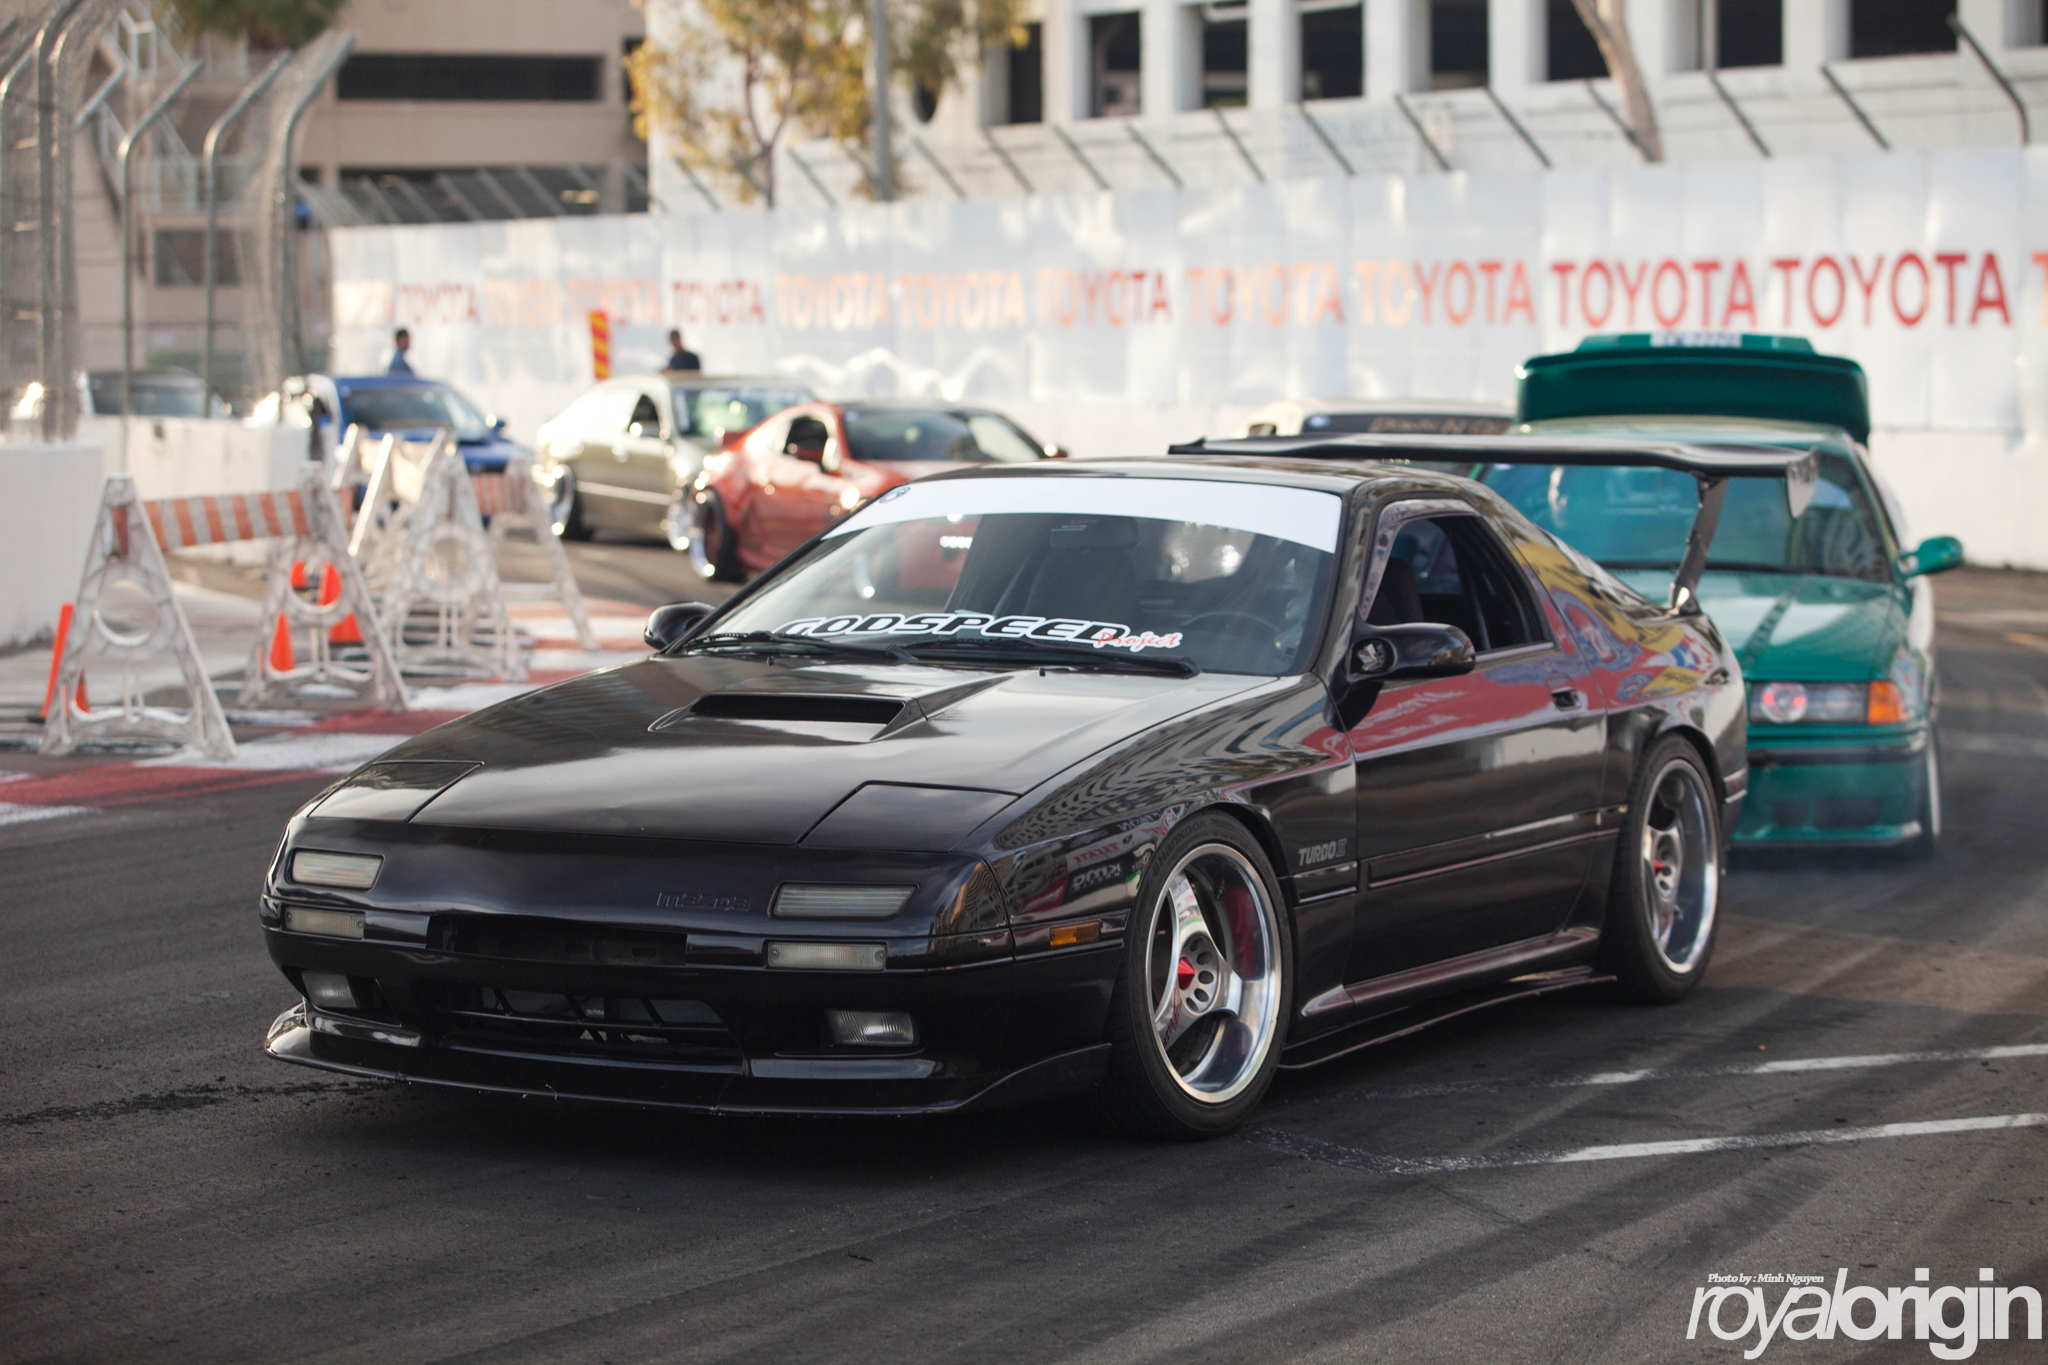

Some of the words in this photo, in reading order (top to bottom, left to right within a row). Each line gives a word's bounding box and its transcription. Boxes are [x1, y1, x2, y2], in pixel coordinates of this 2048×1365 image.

[1033, 267, 1172, 327] TOYOTA
[1187, 262, 1345, 326] TOYOTA
[1357, 260, 1536, 325] TOYOTA
[1551, 259, 1759, 328] TOYOTA
[1773, 251, 2012, 328] TOYOTA
[1093, 629, 1183, 653] Project
